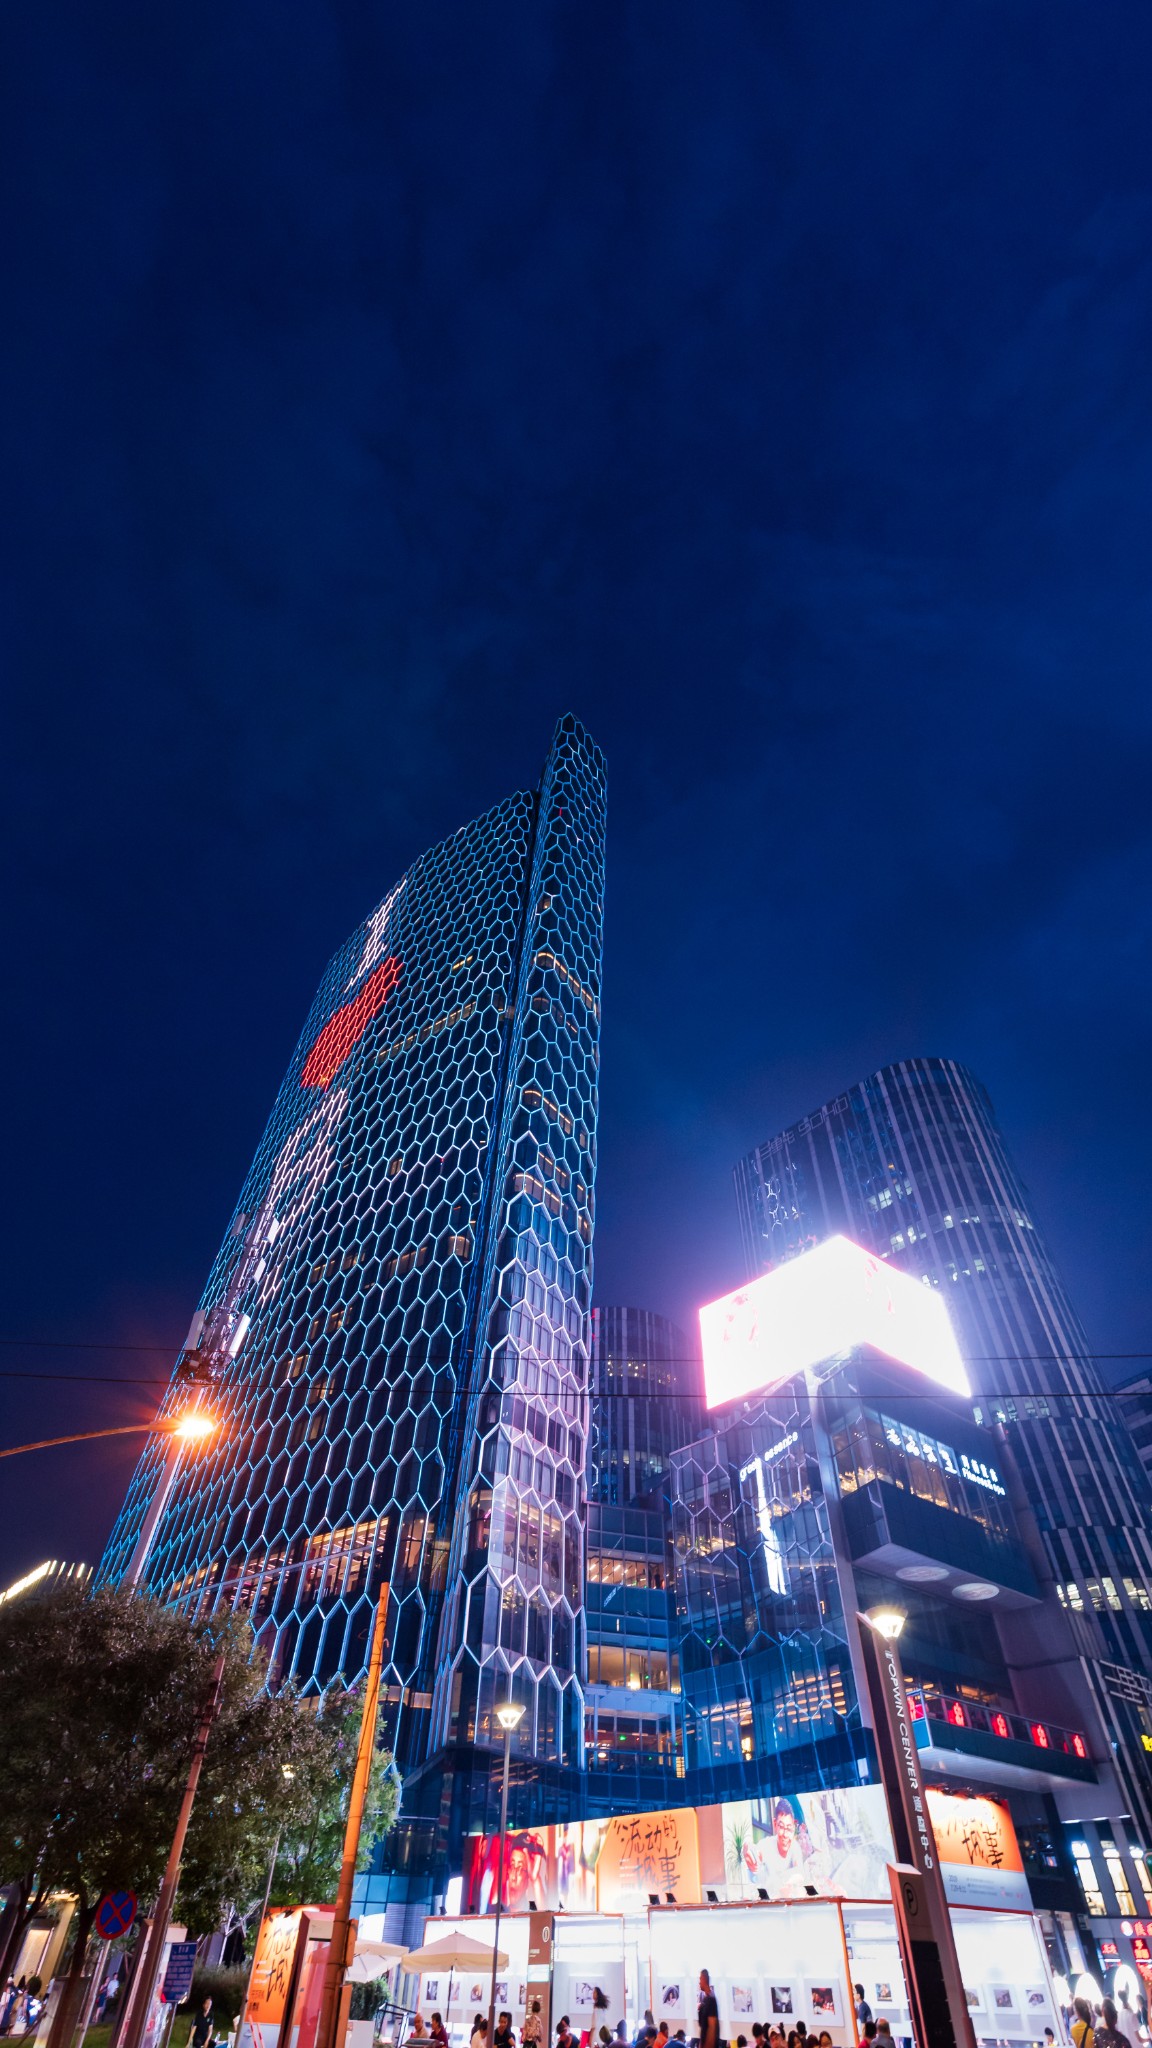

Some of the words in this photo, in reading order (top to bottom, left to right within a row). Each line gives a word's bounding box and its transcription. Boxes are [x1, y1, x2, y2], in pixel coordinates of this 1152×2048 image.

[798, 1097, 848, 1137] SOHO
[764, 1431, 798, 1462] essence
[885, 1650, 905, 1718] TOPWIN
[900, 1723, 918, 1790] CENTER
